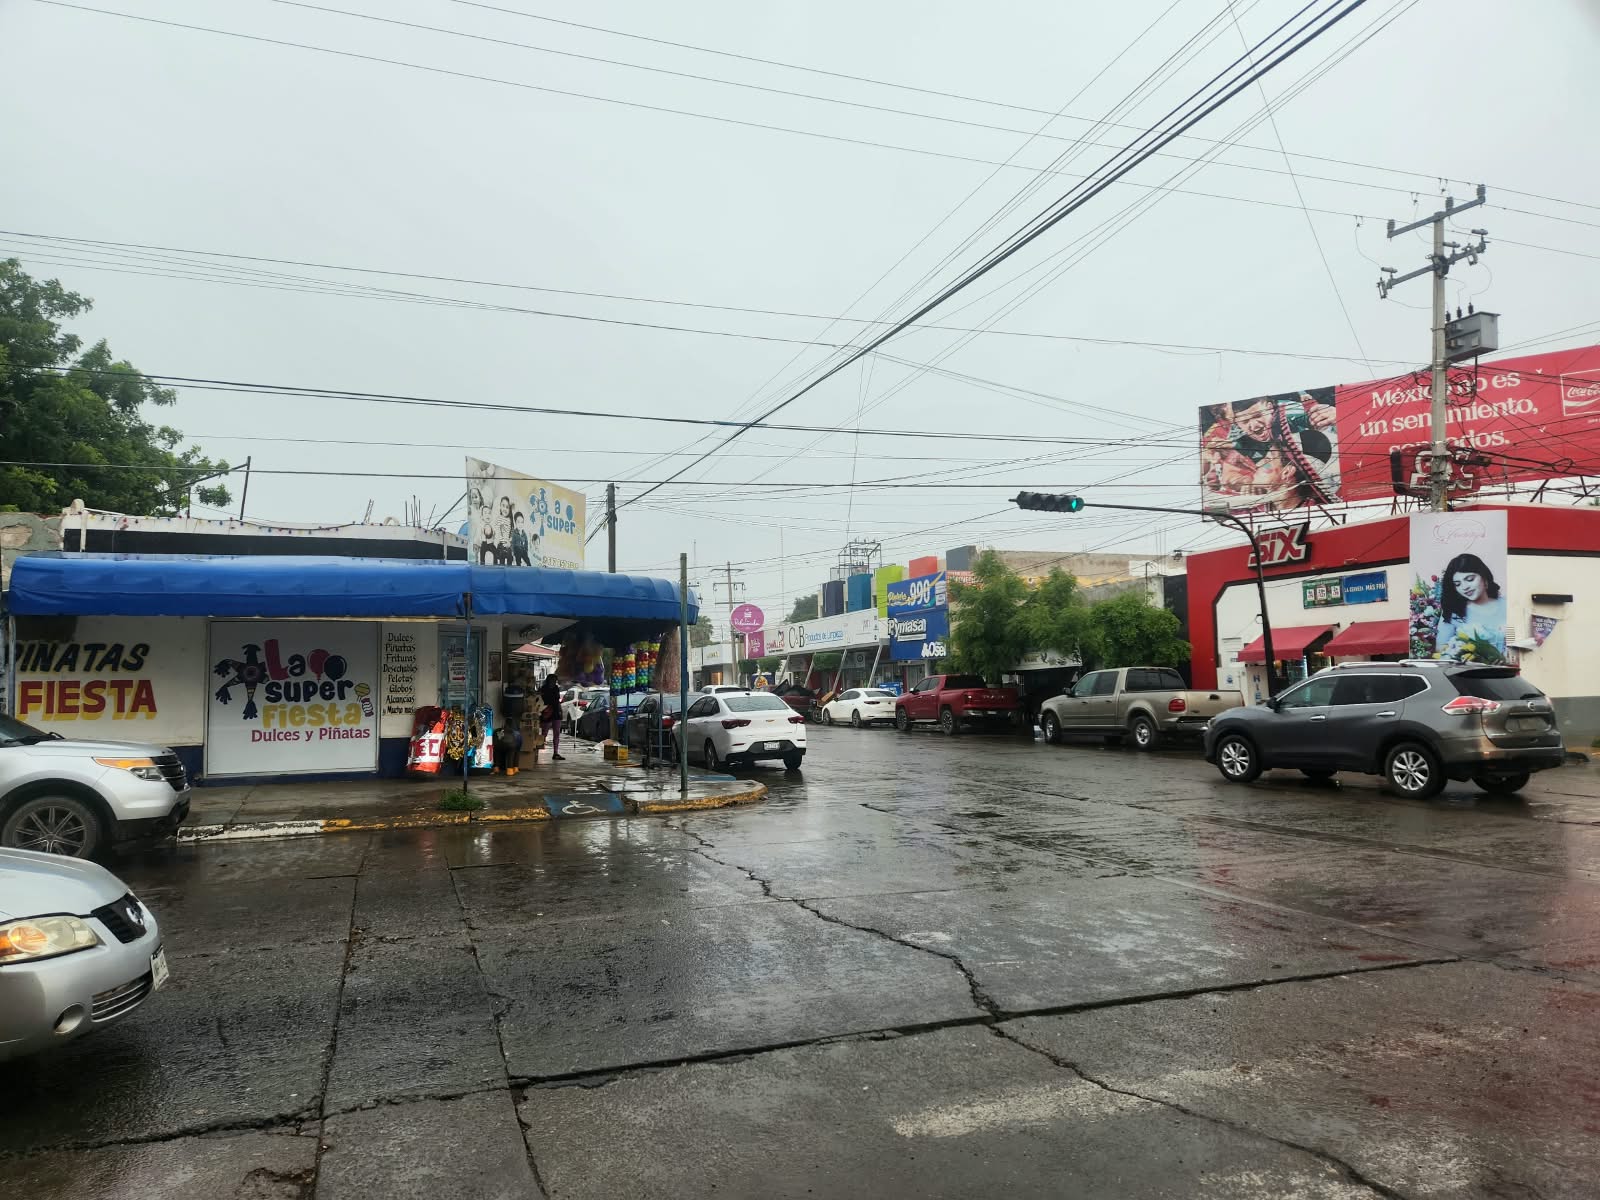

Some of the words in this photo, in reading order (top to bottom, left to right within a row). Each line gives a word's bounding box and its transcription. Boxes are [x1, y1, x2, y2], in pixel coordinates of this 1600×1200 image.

[1491, 372, 1521, 389] es
[1360, 419, 1388, 437] un
[1392, 397, 1539, 433] senmiento,
[547, 515, 575, 534] super
[888, 617, 926, 638] Pymasa
[388, 632, 414, 643] Dulces
[264, 639, 306, 681] La
[386, 653, 417, 663] Frituras
[383, 664, 418, 673] Desechables
[388, 674, 414, 683] Pelotas
[19, 679, 158, 716] FIESTA
[264, 679, 354, 703] super
[389, 684, 413, 694] Globos
[262, 702, 362, 729] Fiesta
[387, 705, 404, 714] Mucho
[251, 728, 300, 742] Dulces
[304, 730, 314, 742] y
[319, 727, 371, 740] Piñatas
